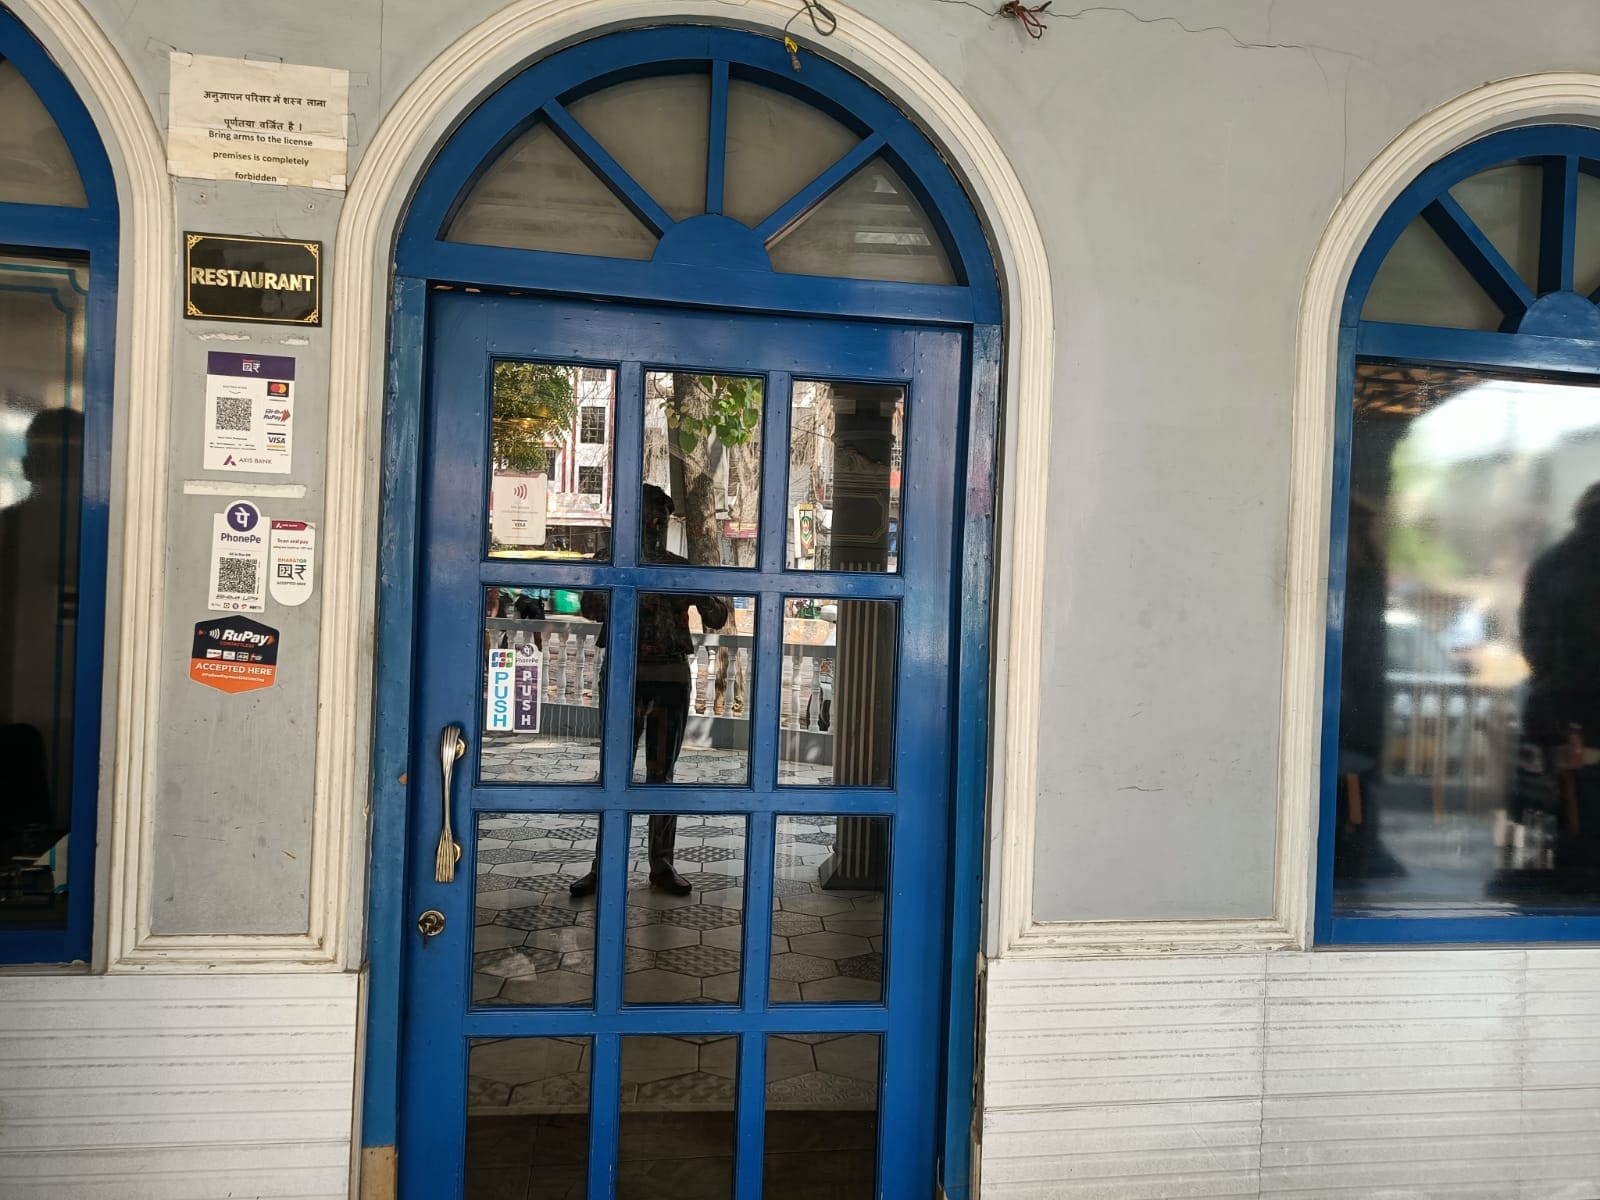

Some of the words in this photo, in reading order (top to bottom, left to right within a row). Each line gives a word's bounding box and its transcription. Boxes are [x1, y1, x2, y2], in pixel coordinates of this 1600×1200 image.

[244, 92, 272, 103] परिसर
[272, 94, 280, 104] में
[306, 98, 327, 108] लाना
[224, 116, 255, 130] पूर्णतया
[259, 120, 284, 130] वर्जित
[288, 121, 295, 132] है
[209, 130, 231, 141] Bring
[233, 134, 254, 142] arms
[257, 134, 266, 143] to
[268, 135, 282, 144] the
[284, 137, 313, 147] license
[213, 151, 252, 161] premises
[253, 154, 260, 162] is
[262, 155, 309, 167] completely
[235, 171, 277, 182] forbidden
[191, 267, 314, 292] RESTAURANT
[268, 436, 286, 444] VISA
[221, 532, 261, 544] PhonePe
[222, 629, 269, 646] RuPay
[195, 662, 245, 673] ACCEPTED
[248, 668, 273, 676] HERE
[493, 671, 509, 727] PUSH
[521, 670, 532, 726] PUSH
